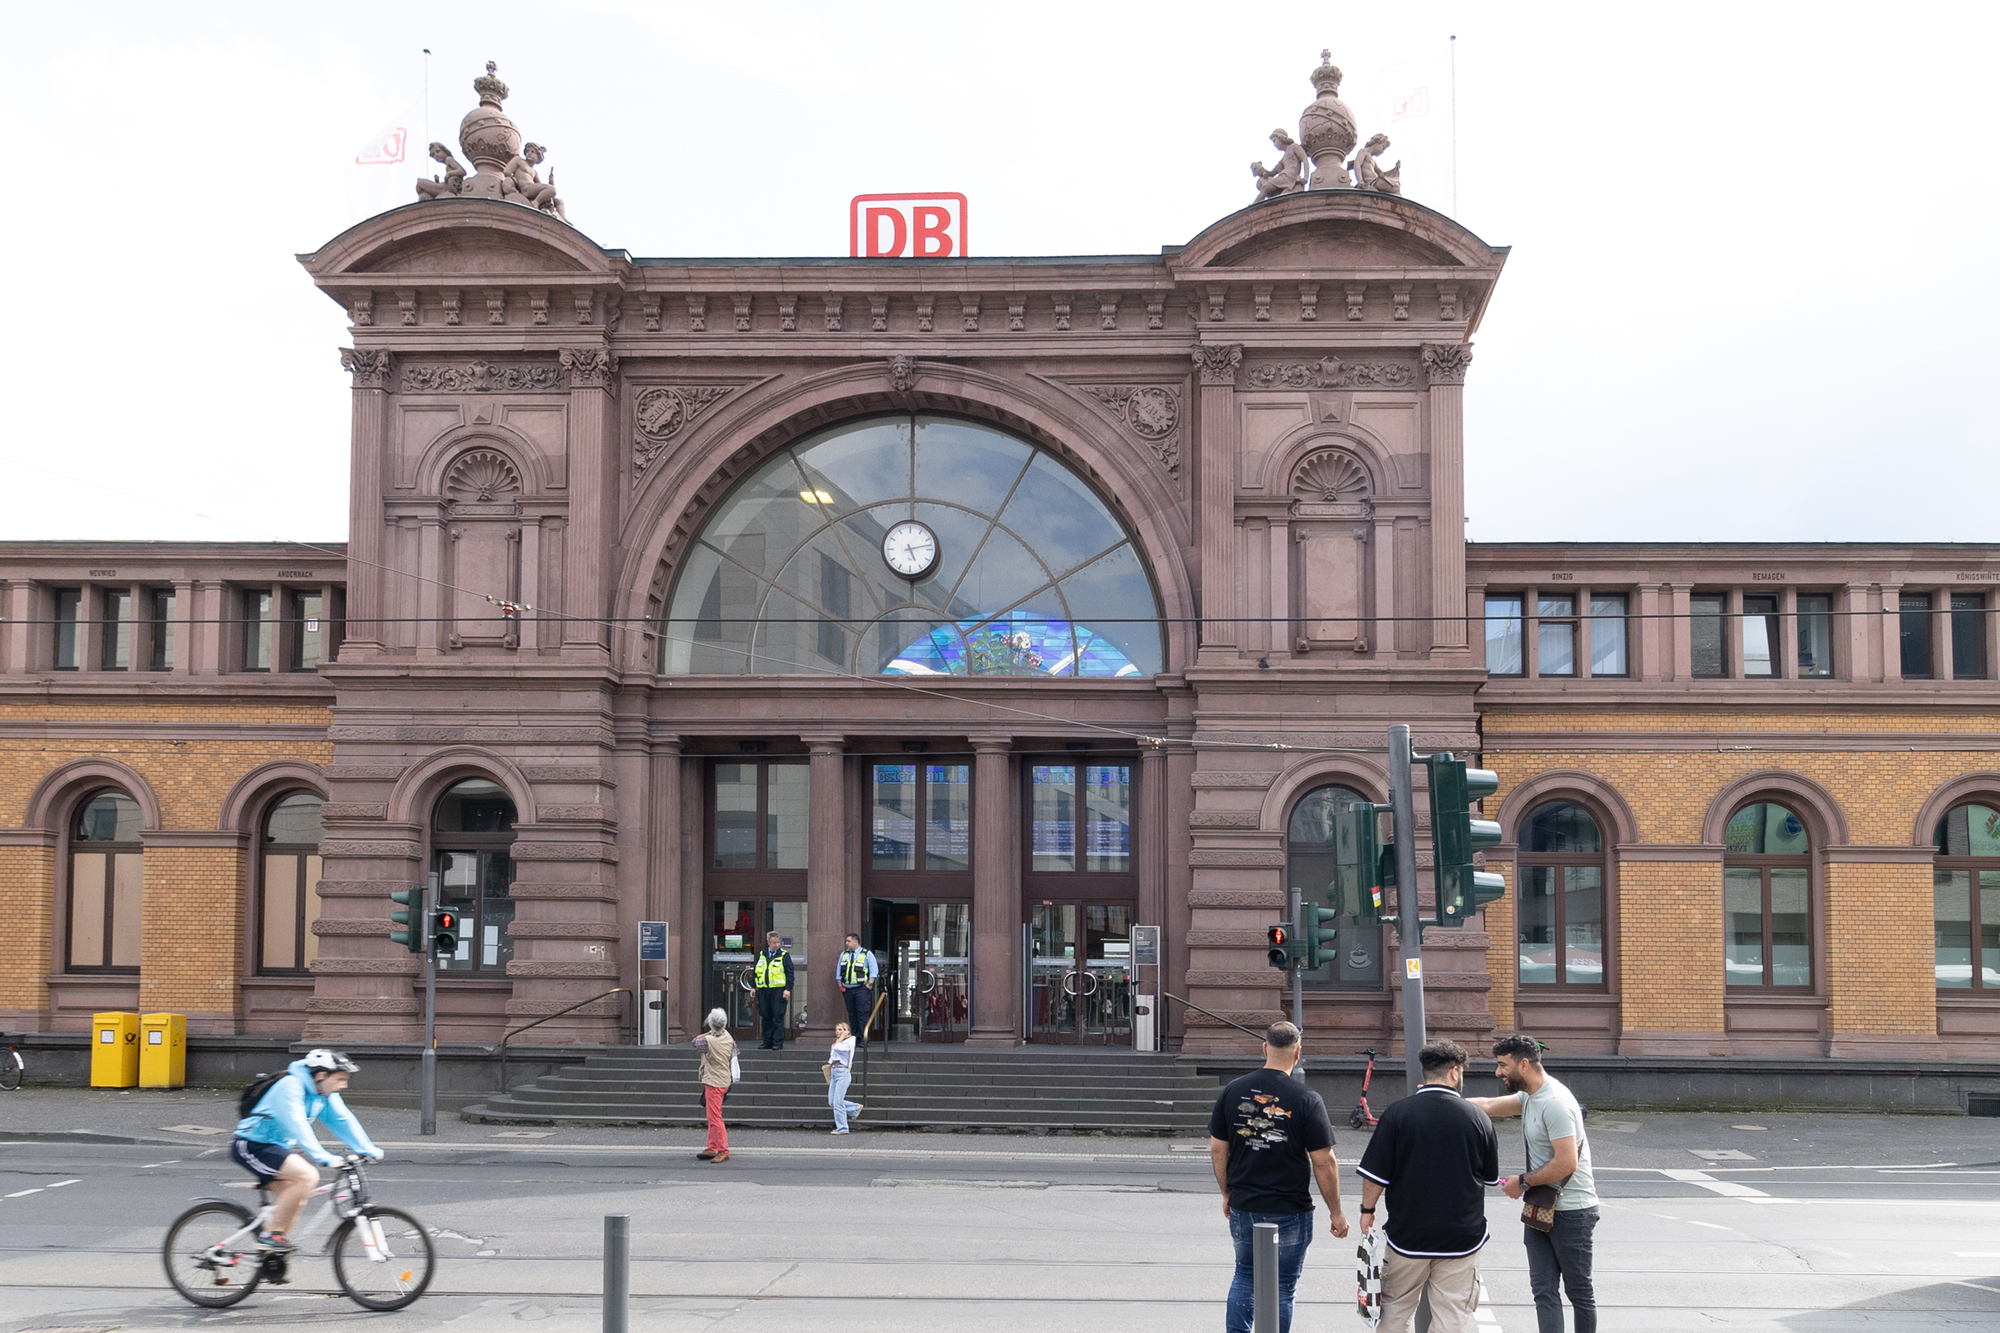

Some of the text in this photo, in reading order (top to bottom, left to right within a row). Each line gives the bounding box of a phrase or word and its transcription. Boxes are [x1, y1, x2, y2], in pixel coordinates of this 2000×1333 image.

[866, 206, 953, 257] DB
[89, 569, 116, 577] NEUWIED
[277, 570, 314, 579] ANDERNACH
[1551, 573, 1573, 581] SINZIG
[1752, 573, 1785, 581] REMAGEN
